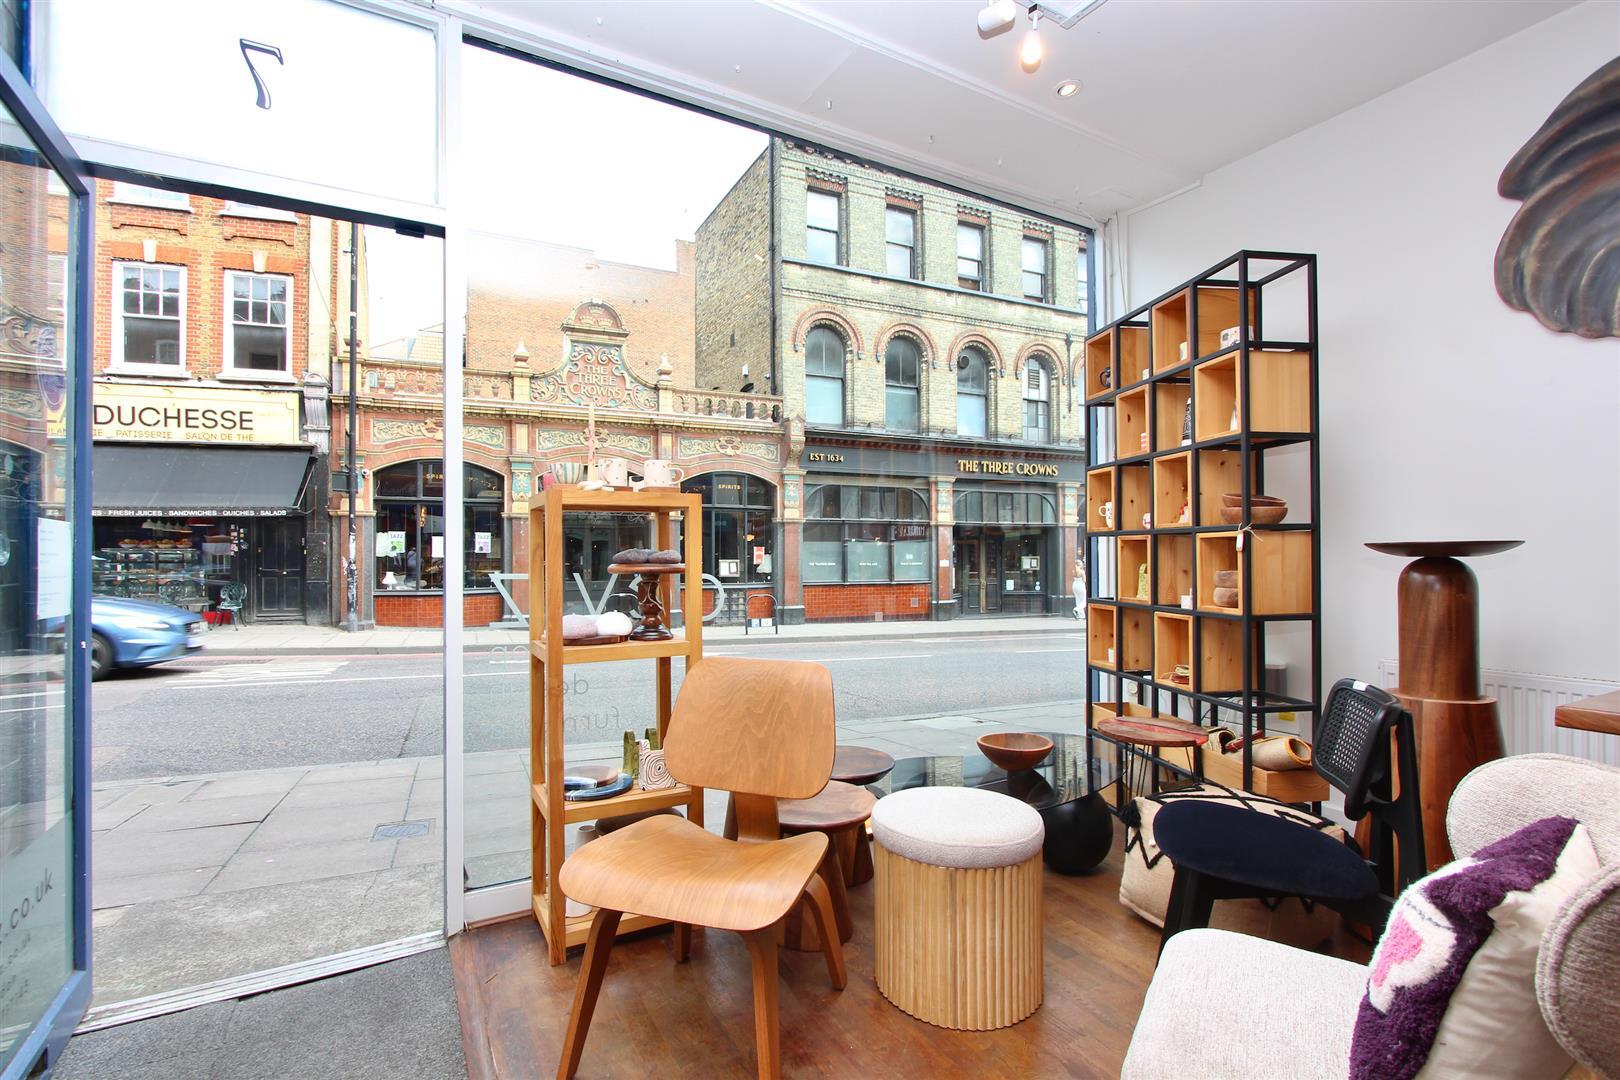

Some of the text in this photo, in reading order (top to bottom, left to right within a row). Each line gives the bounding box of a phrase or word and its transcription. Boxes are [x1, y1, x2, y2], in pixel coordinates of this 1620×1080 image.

[583, 365, 609, 375] THE
[575, 372, 618, 387] THREE
[569, 384, 621, 398] CROWNS
[93, 404, 254, 430] DUCHESSE
[116, 429, 173, 439] PATISSERIE
[185, 431, 218, 441] SALON
[220, 433, 233, 441] DE
[809, 452, 844, 462] EST 1634
[958, 460, 1058, 476] THE THREE CROWNS
